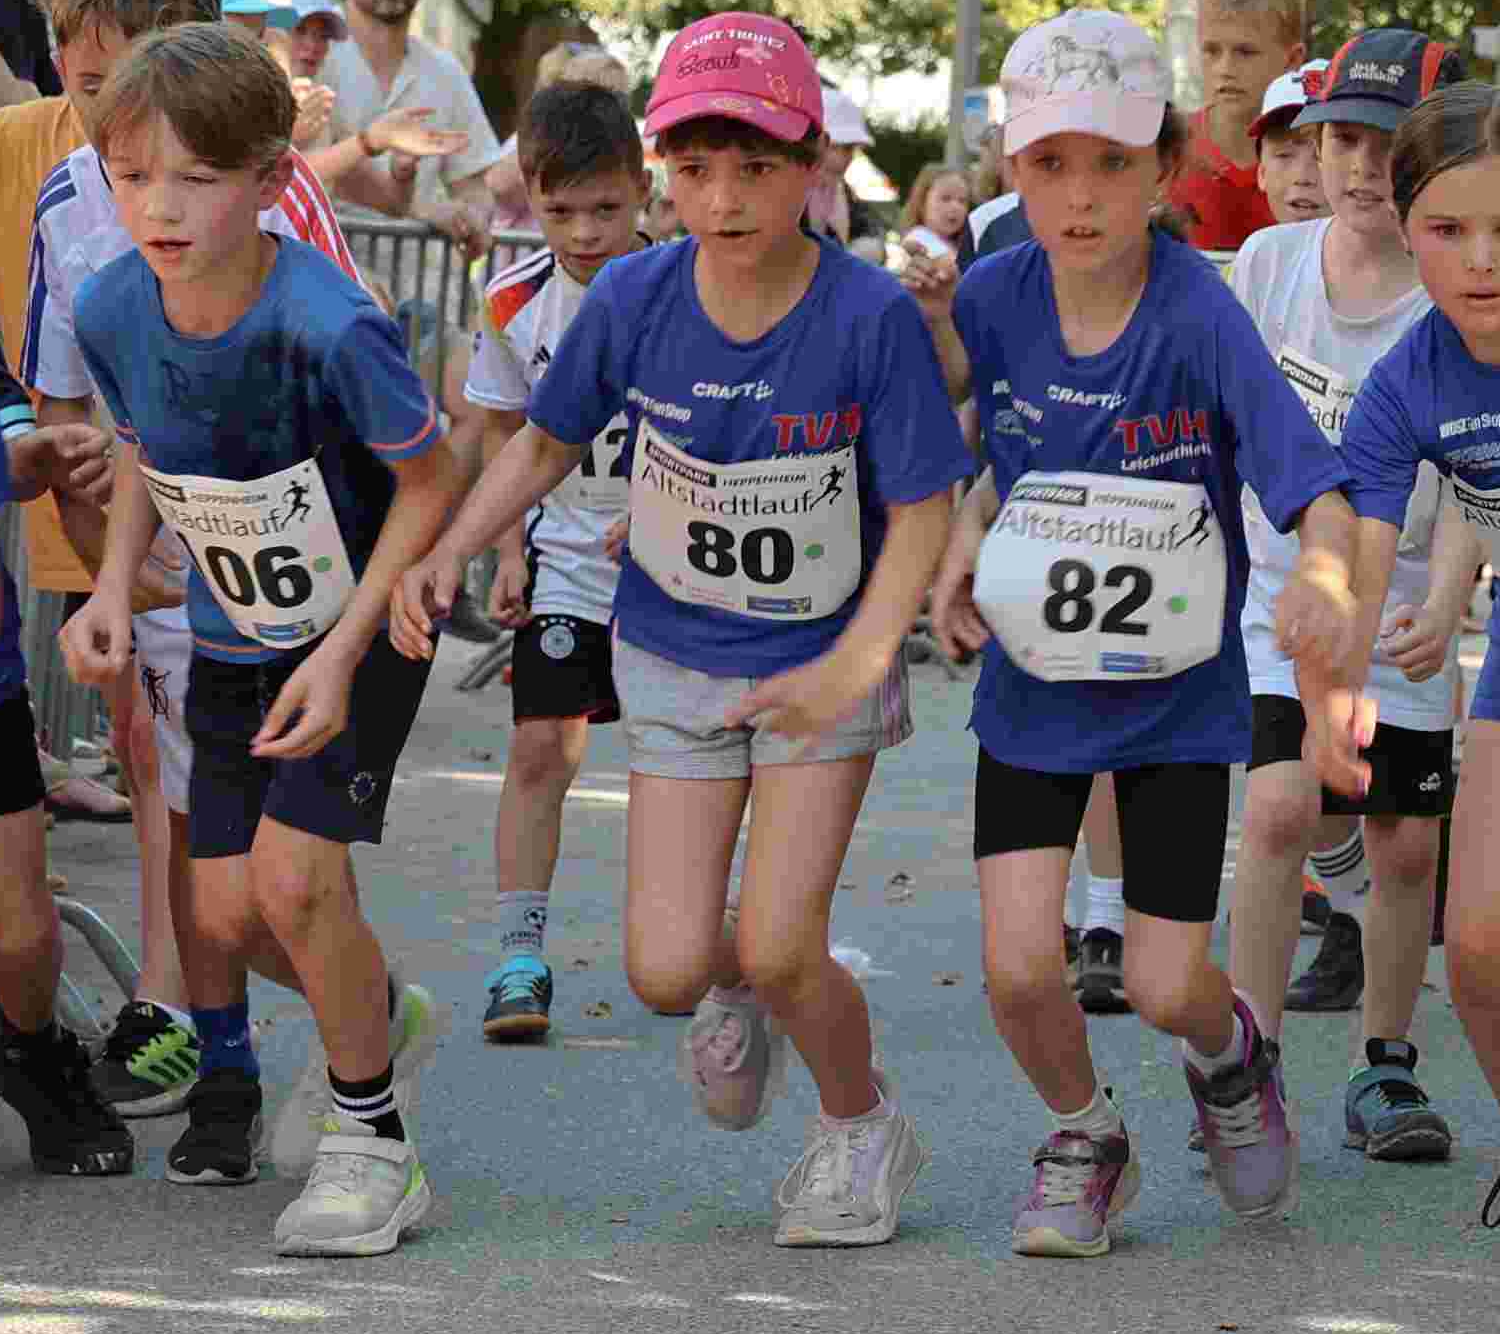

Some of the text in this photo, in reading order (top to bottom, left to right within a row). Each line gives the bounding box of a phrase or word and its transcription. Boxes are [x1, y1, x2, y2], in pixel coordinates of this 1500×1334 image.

[692, 381, 753, 400] CRAFT
[1115, 408, 1209, 454] TVH
[642, 464, 812, 517] Altstadtlauf
[687, 519, 796, 585] 80
[995, 505, 1181, 553] Altstadtlauf
[1043, 558, 1154, 636] 82
